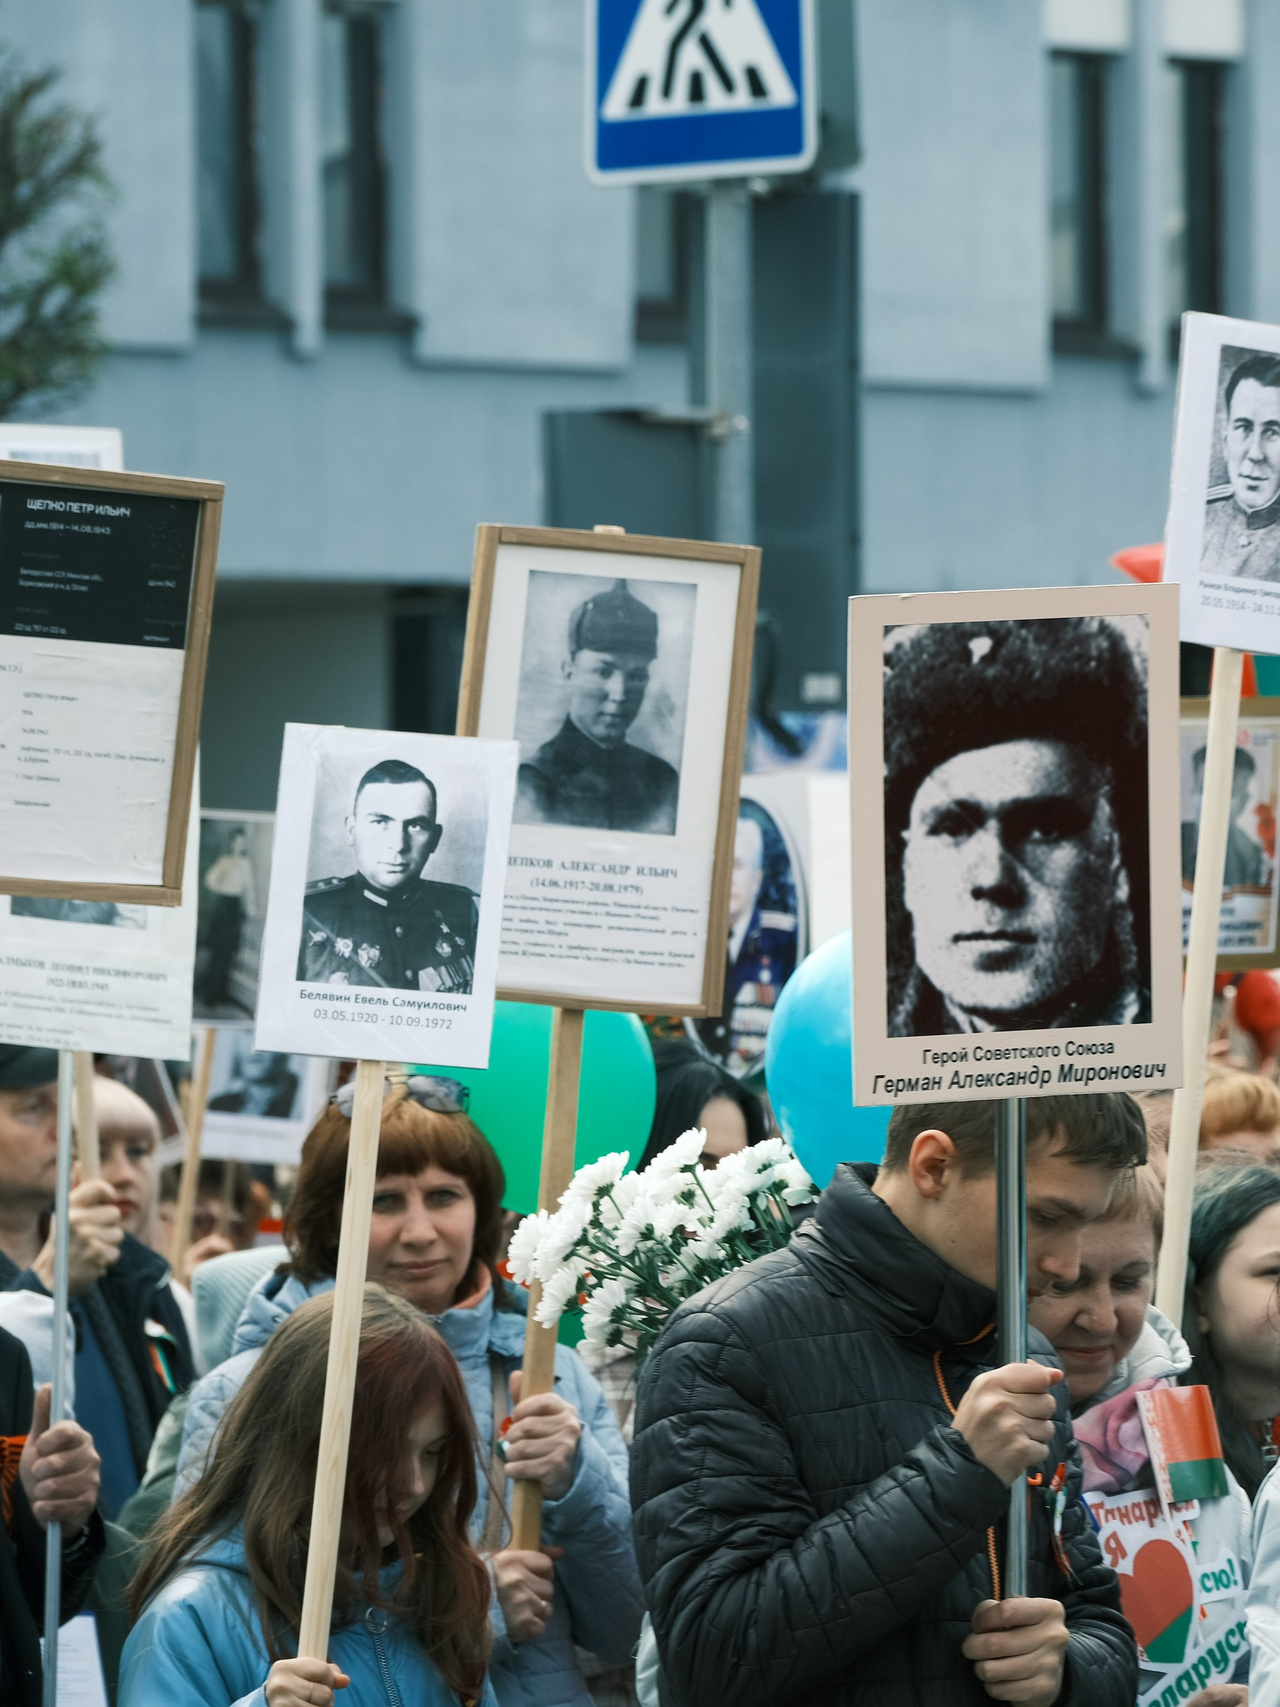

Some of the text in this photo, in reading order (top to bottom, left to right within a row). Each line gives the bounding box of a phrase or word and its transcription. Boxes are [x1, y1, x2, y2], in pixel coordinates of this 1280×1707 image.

[67, 503, 94, 514] ПЕТР
[95, 505, 131, 517] ИЛЬИЧ
[559, 859, 631, 876] АЛЕКСАНДР
[636, 866, 678, 879] ИЛЬИЧ
[300, 989, 468, 1013] Белявин Евель Самуилович
[313, 1008, 379, 1024] 03.05.1920
[389, 1015, 453, 1030] 10.09.1972
[922, 1040, 1116, 1068] Герой Советского Союза
[872, 1062, 1167, 1097] Герман Александр Миронович
[1104, 1531, 1128, 1568] Я
